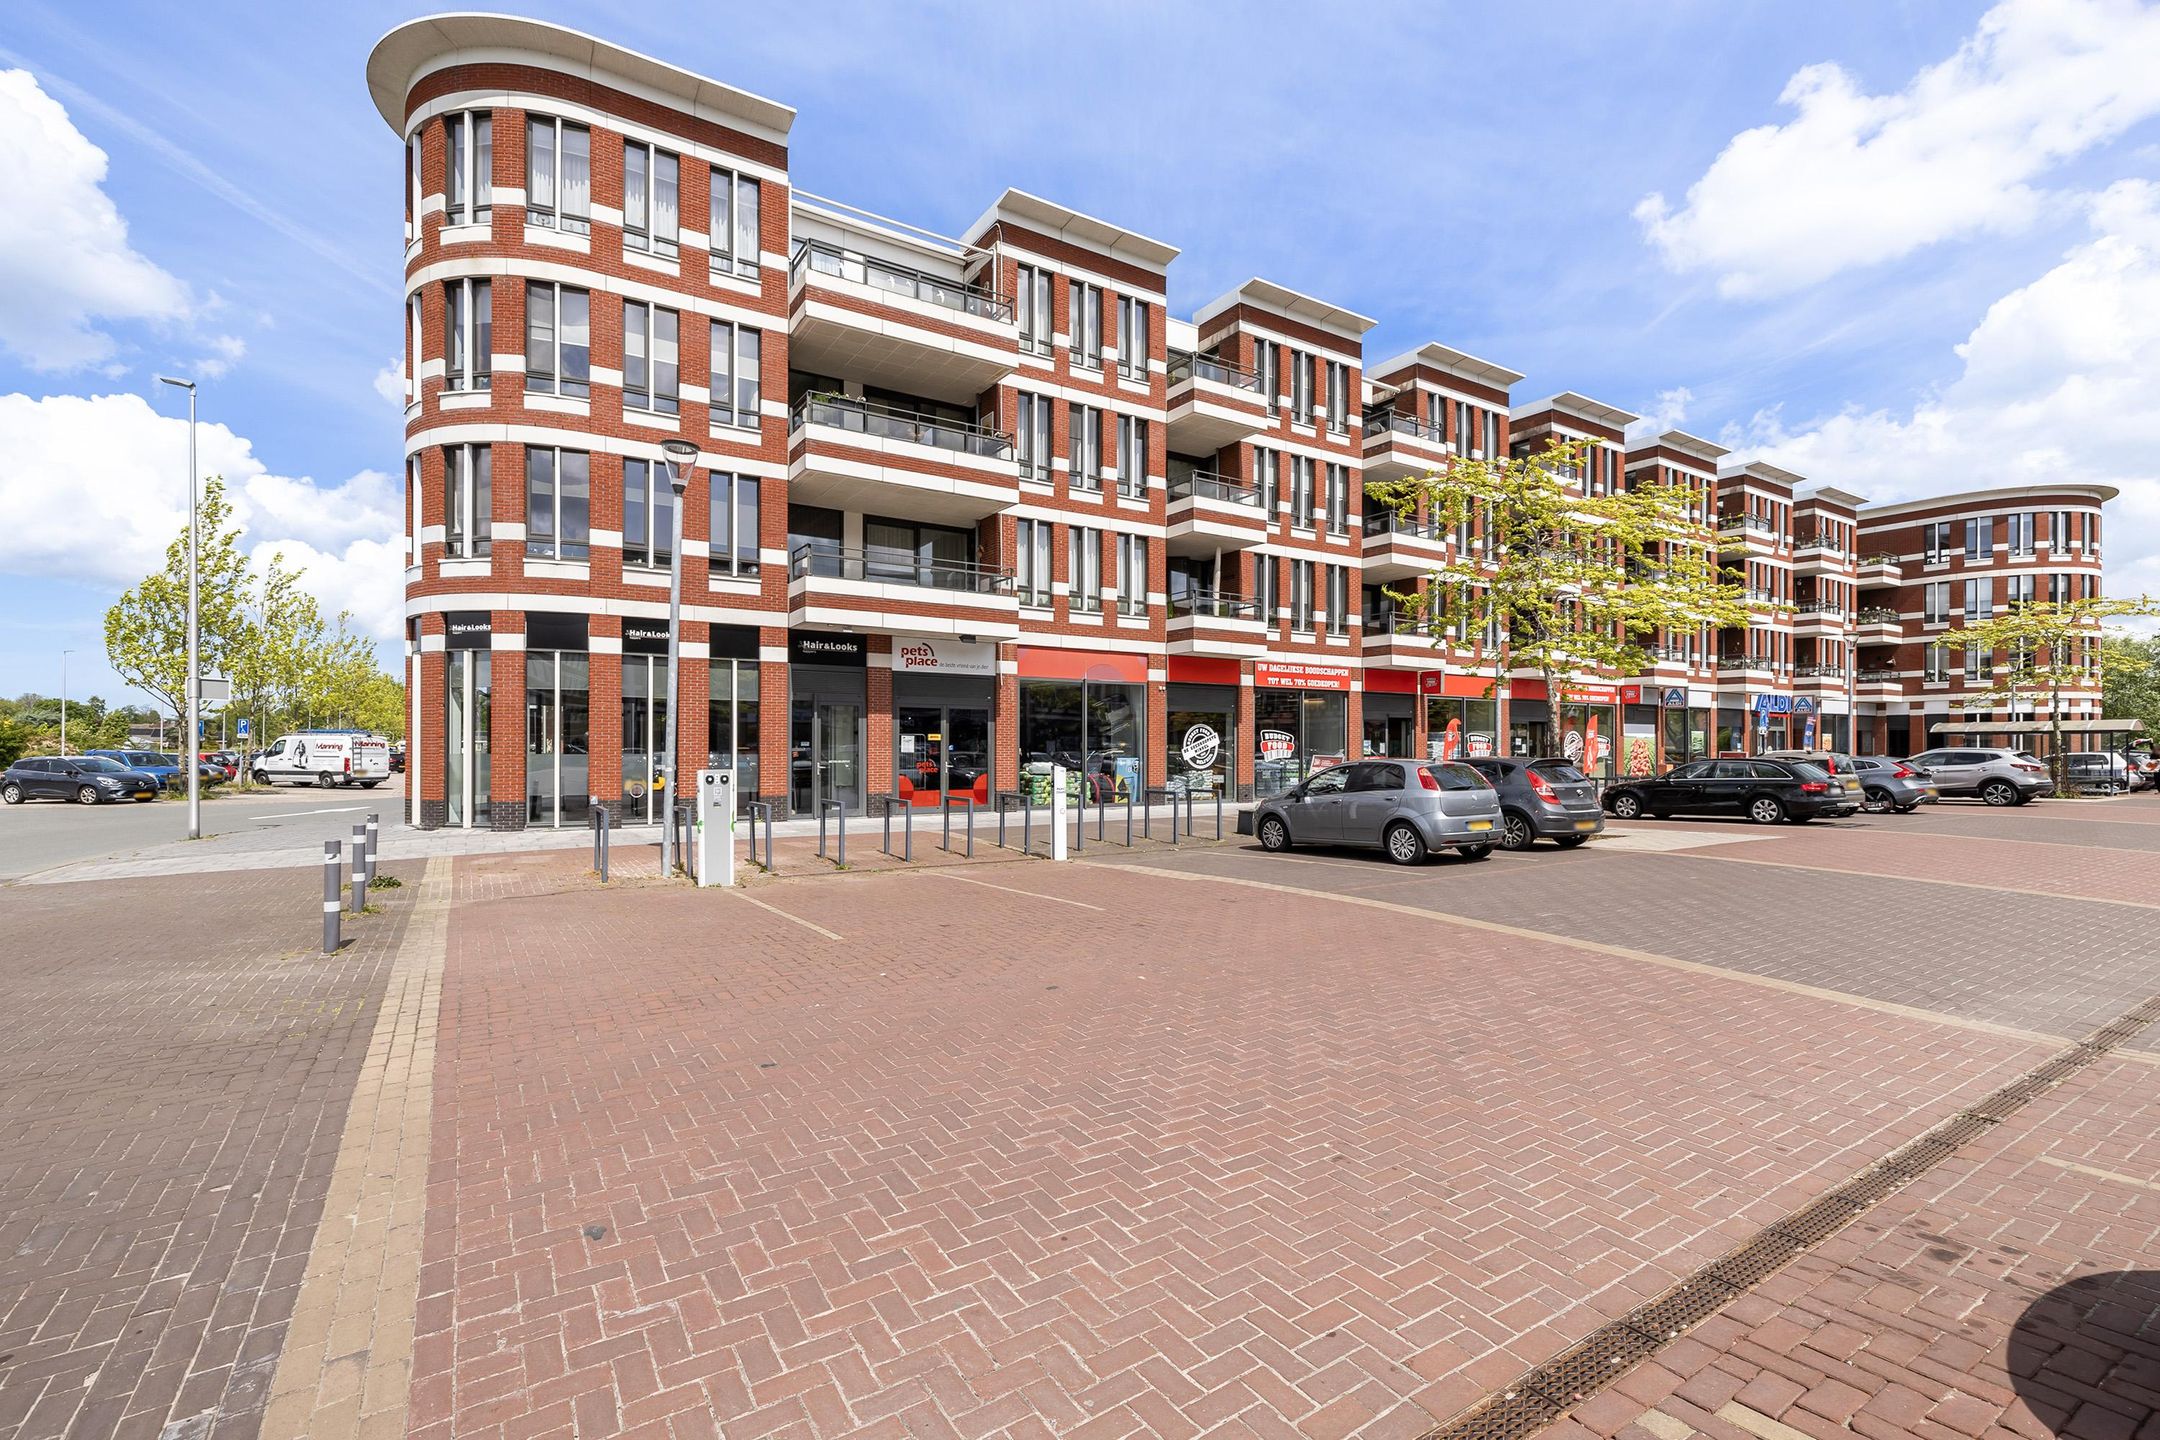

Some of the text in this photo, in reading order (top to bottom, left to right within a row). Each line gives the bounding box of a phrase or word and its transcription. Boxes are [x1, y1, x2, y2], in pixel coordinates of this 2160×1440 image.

[452, 623, 491, 631] Hair&Looks
[629, 630, 670, 638] Hair&Look
[803, 641, 858, 652] Hair&Looks
[901, 646, 928, 658] pets
[906, 656, 938, 668] place
[1257, 663, 1349, 677] UW DAGELIJKSE BOODSCHAPPEN
[1267, 677, 1279, 685] TOT
[1280, 678, 1293, 686] WEL
[1294, 679, 1306, 687] 70%
[1756, 694, 1792, 712] ALDI
[240, 720, 247, 728] P
[1264, 732, 1291, 740] BUDGET
[315, 742, 343, 751] Manning
[354, 740, 386, 749] Manning
[1267, 741, 1288, 751] FOOD
